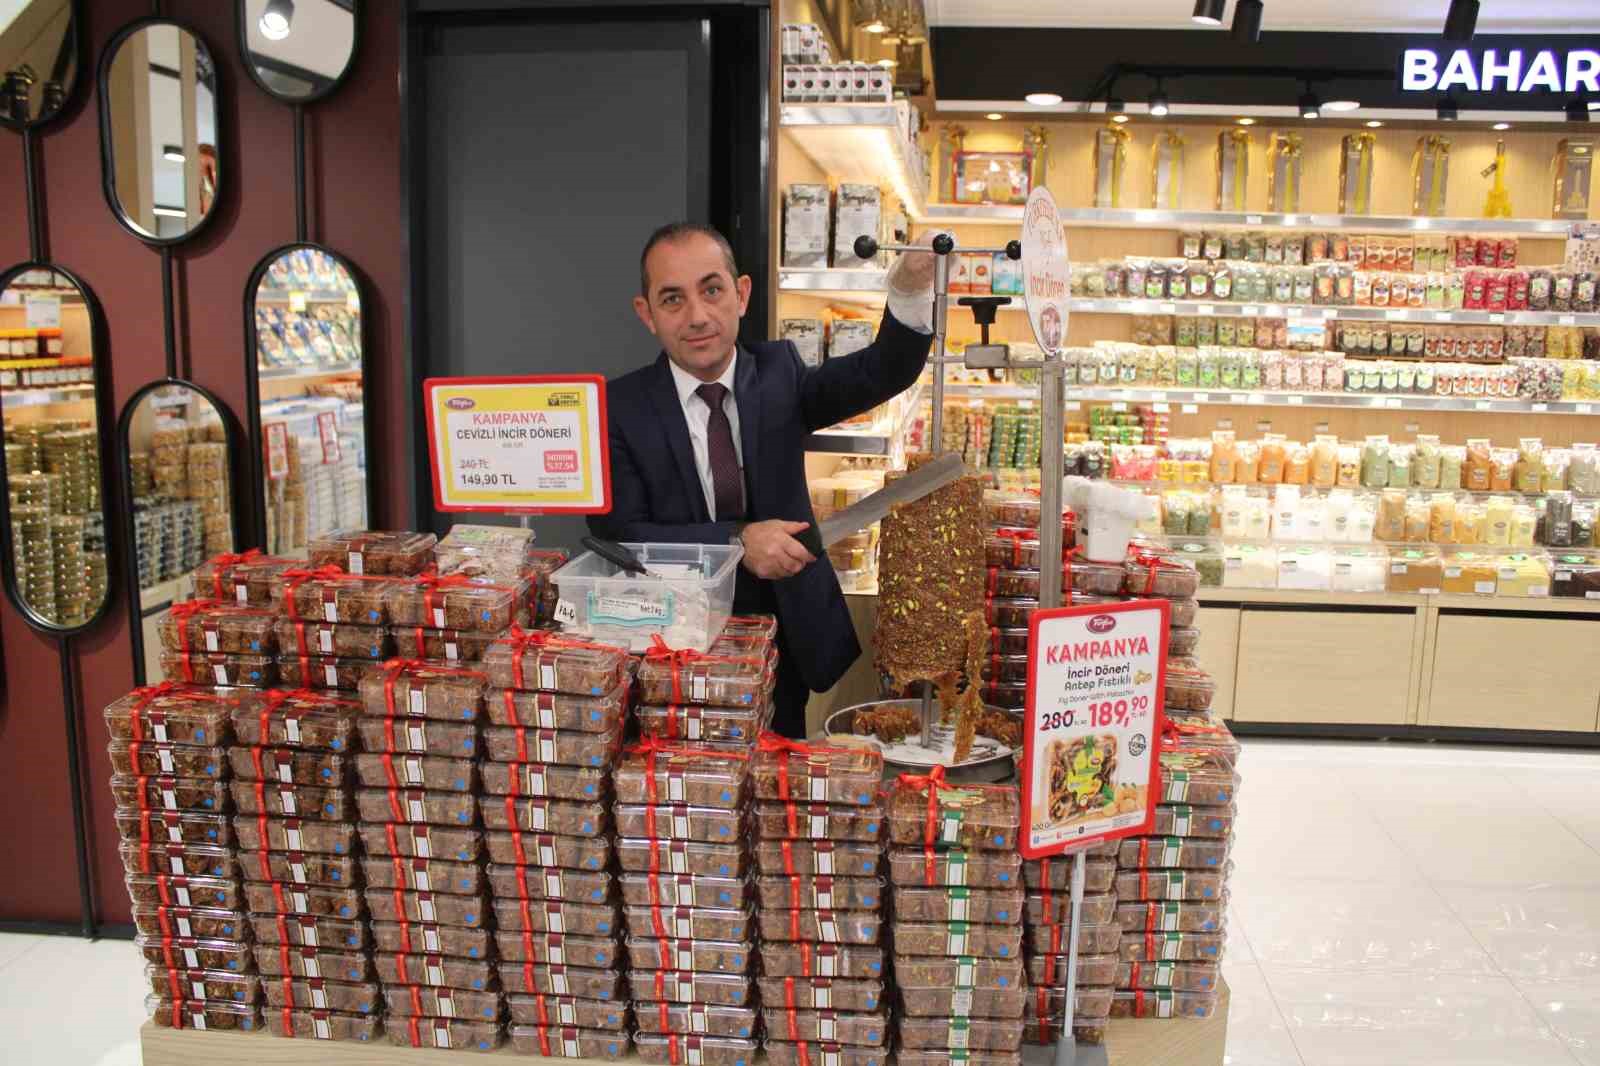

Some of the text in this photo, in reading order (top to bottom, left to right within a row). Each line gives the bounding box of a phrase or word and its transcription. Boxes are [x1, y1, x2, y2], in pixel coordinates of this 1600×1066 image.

[1402, 49, 1600, 92] BAHAR
[473, 412, 547, 425] KAMPANYA
[457, 426, 572, 440] CEVİZLİ İNCİR DÖNERİ
[461, 473, 517, 486] 149,90 TL
[1046, 636, 1150, 665] KAMPANYA
[1067, 662, 1130, 679] İncir Döneri
[1064, 676, 1131, 691] Antep Fıstıklı
[1042, 710, 1075, 730] 280
